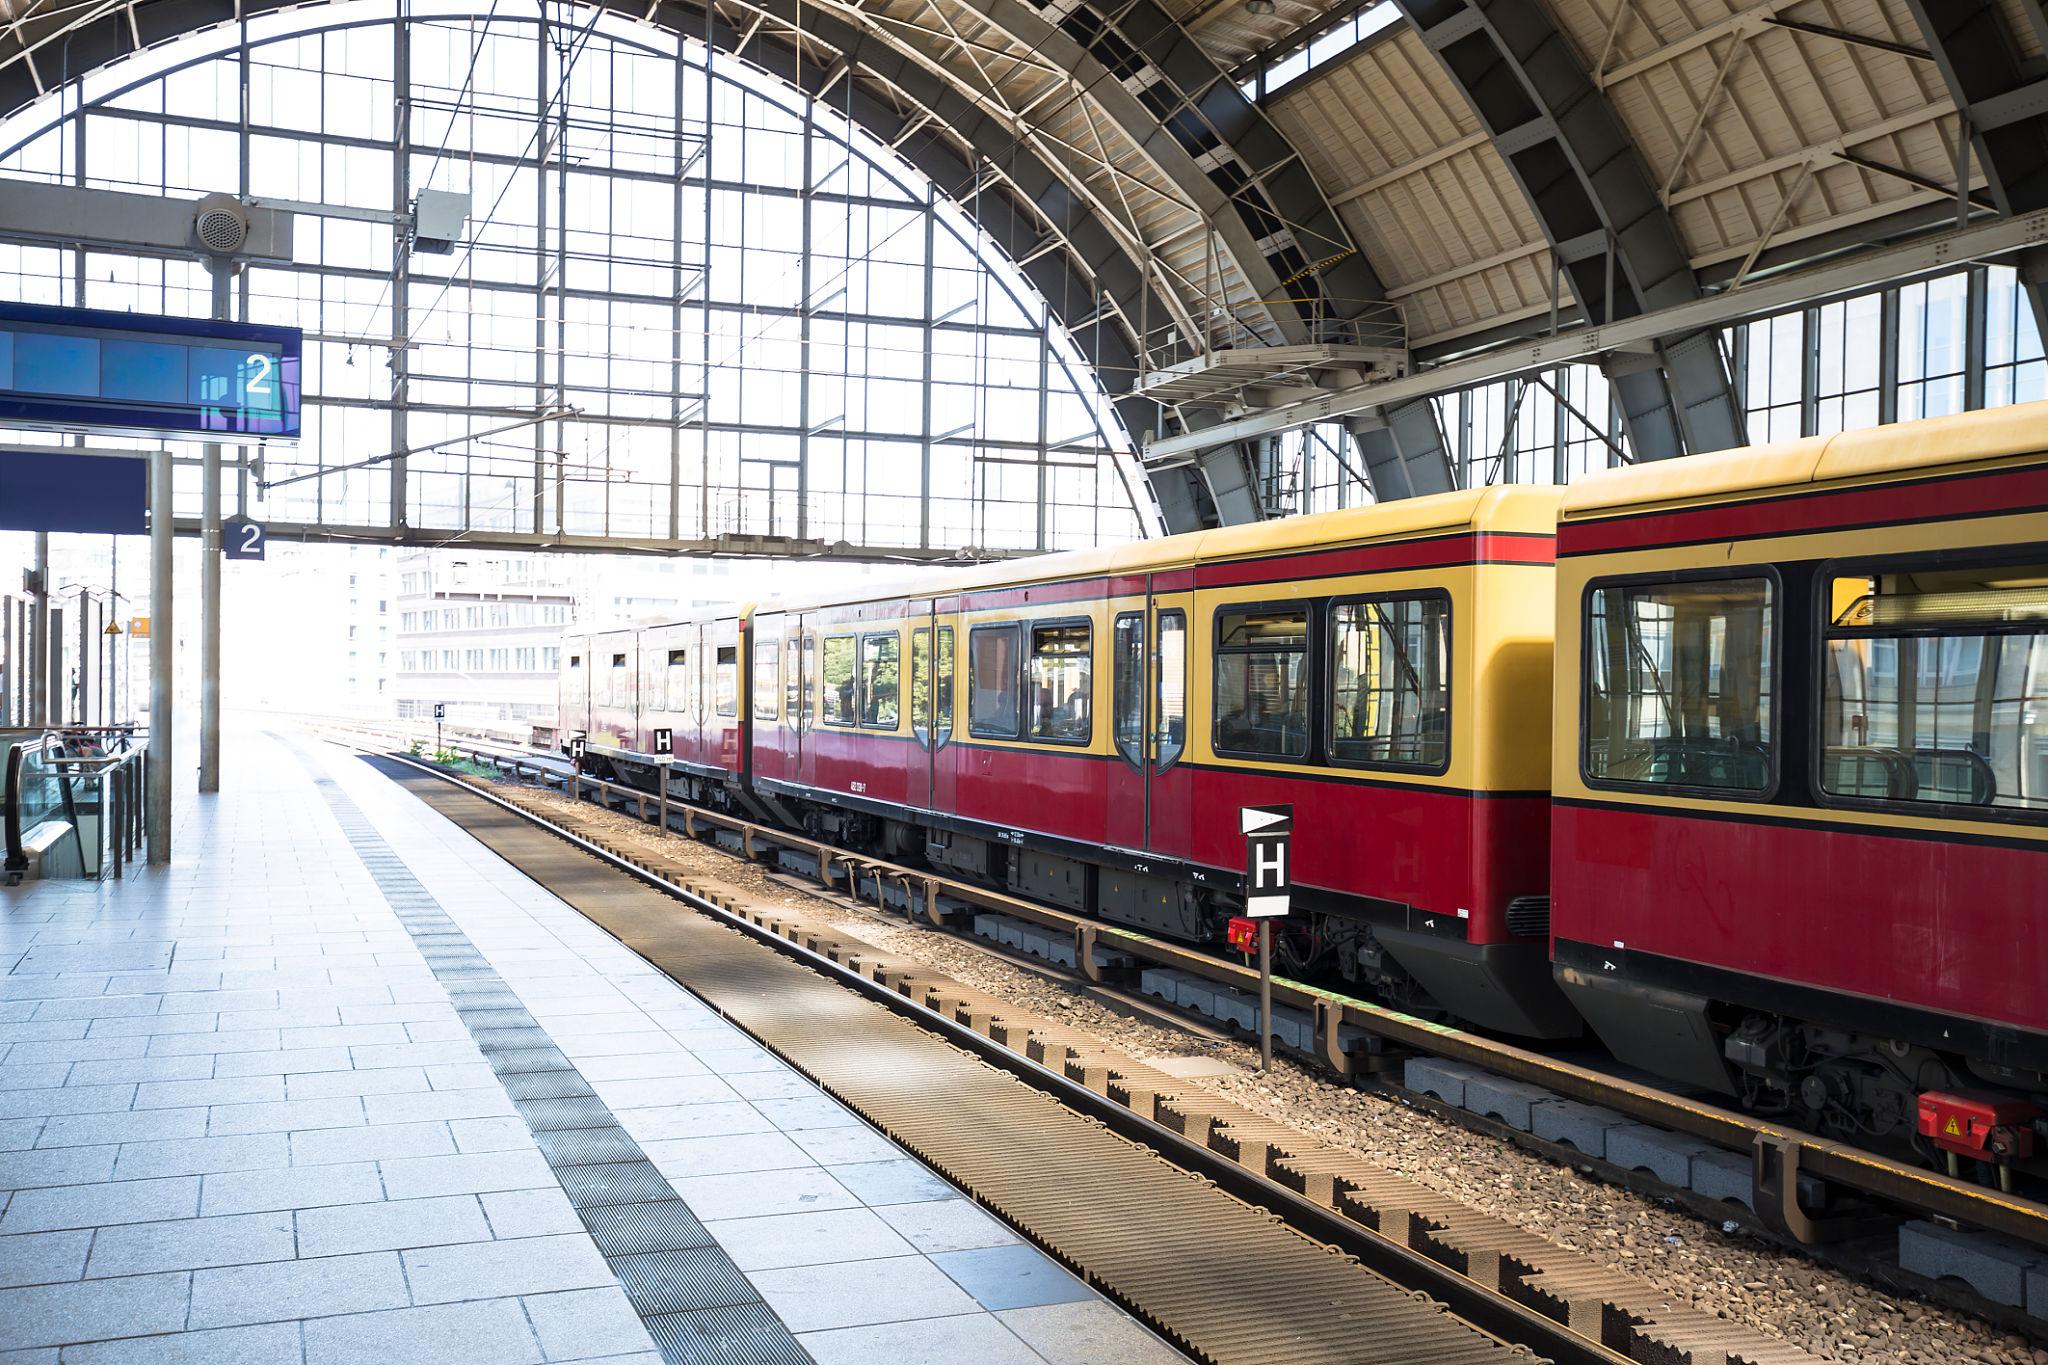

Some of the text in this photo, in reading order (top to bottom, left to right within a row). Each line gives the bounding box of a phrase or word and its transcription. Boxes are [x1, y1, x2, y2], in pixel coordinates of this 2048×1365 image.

[246, 354, 272, 394] 2
[240, 524, 261, 553] 2
[436, 705, 443, 716] H
[572, 741, 584, 757] H
[656, 731, 671, 750] H
[1256, 843, 1284, 888] H
